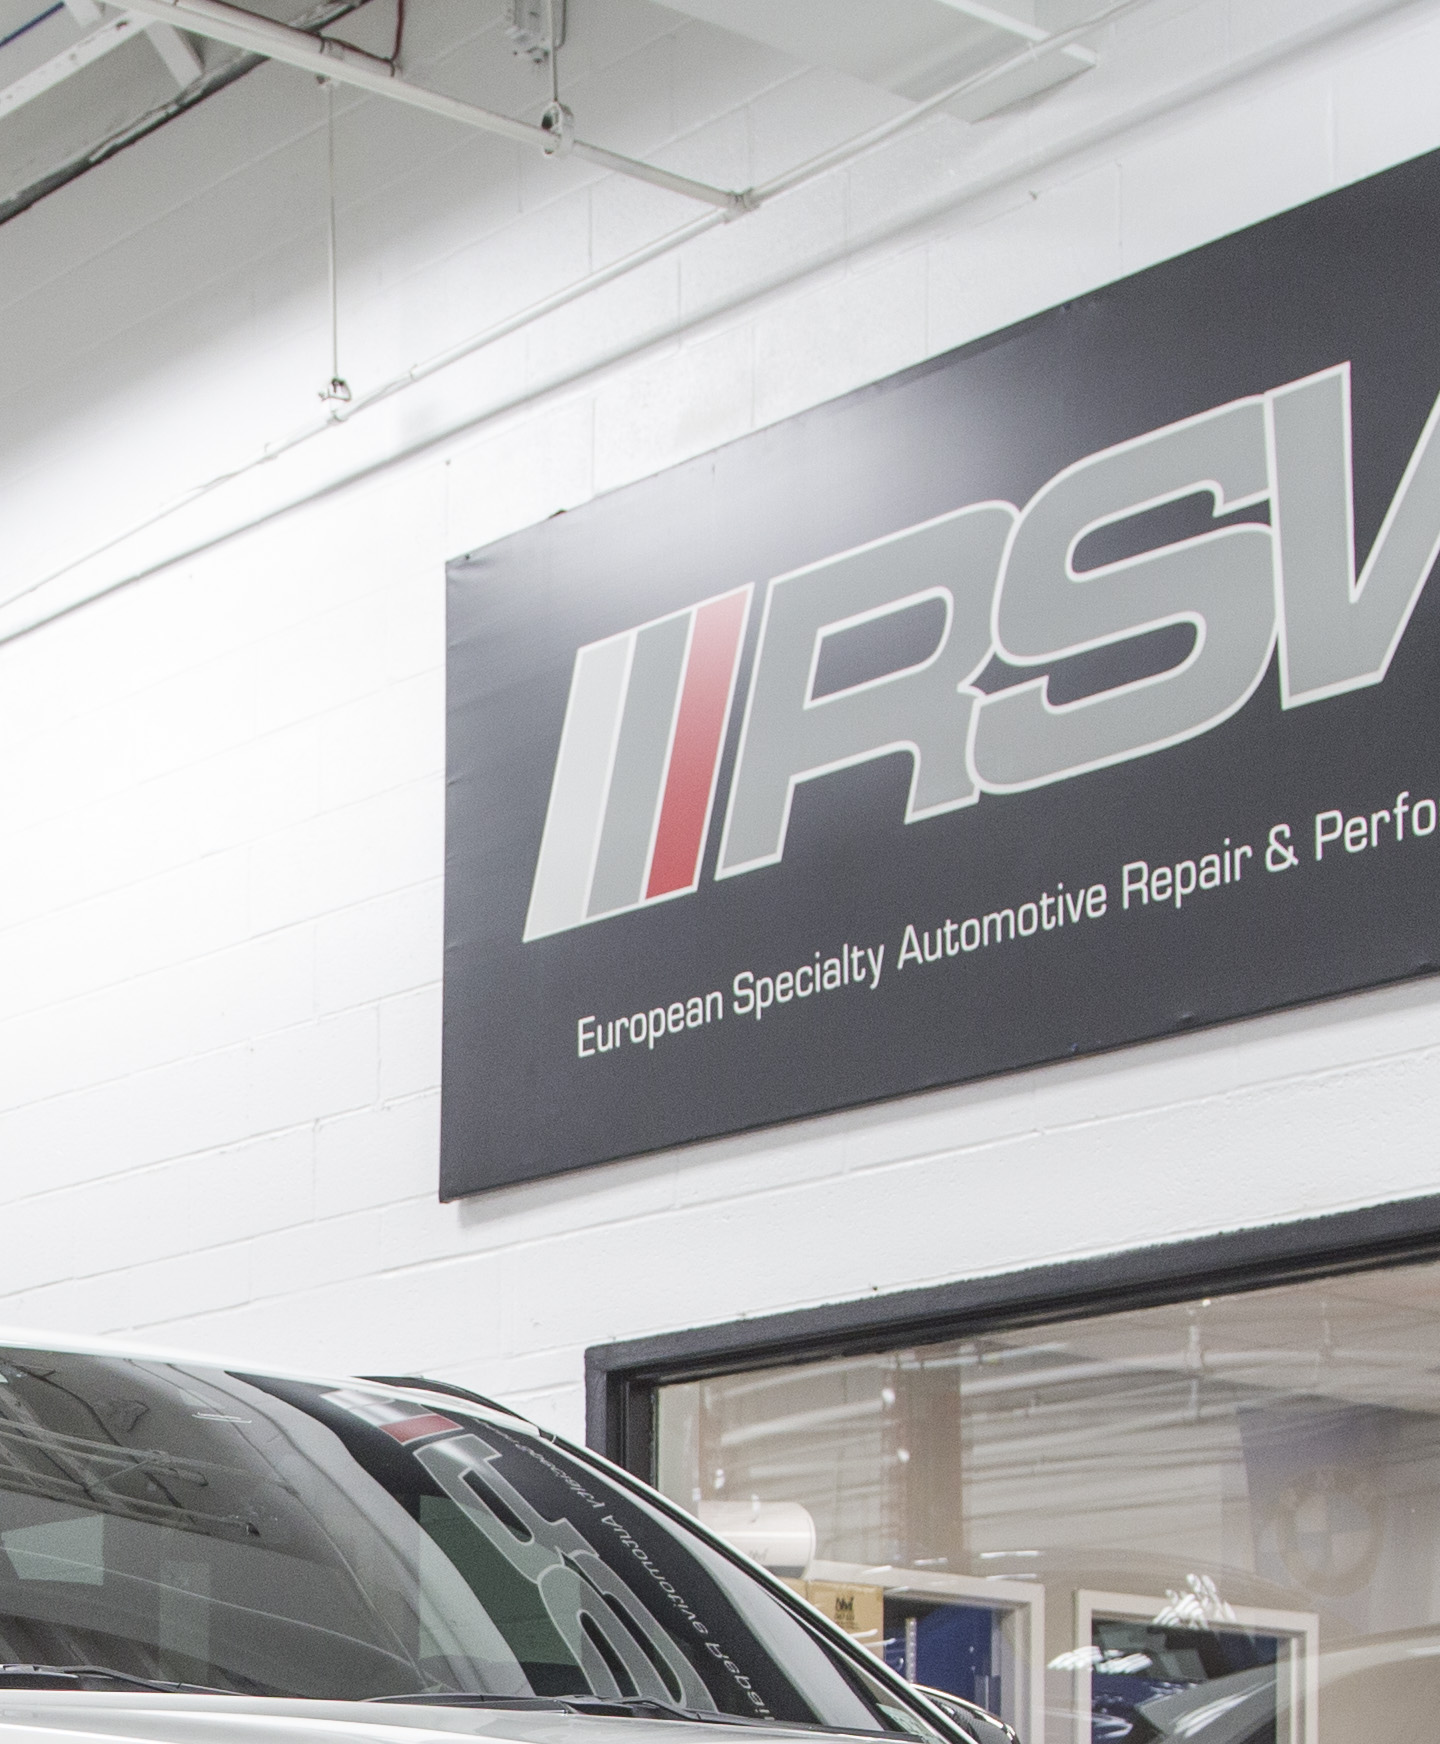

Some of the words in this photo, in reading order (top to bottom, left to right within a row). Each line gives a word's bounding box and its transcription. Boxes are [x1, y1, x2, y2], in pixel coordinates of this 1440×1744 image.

[577, 990, 724, 1058] European
[732, 943, 885, 1020] Specialty
[897, 880, 1107, 971] Automotive
[1122, 837, 1253, 910] Repair
[1265, 823, 1299, 872] &
